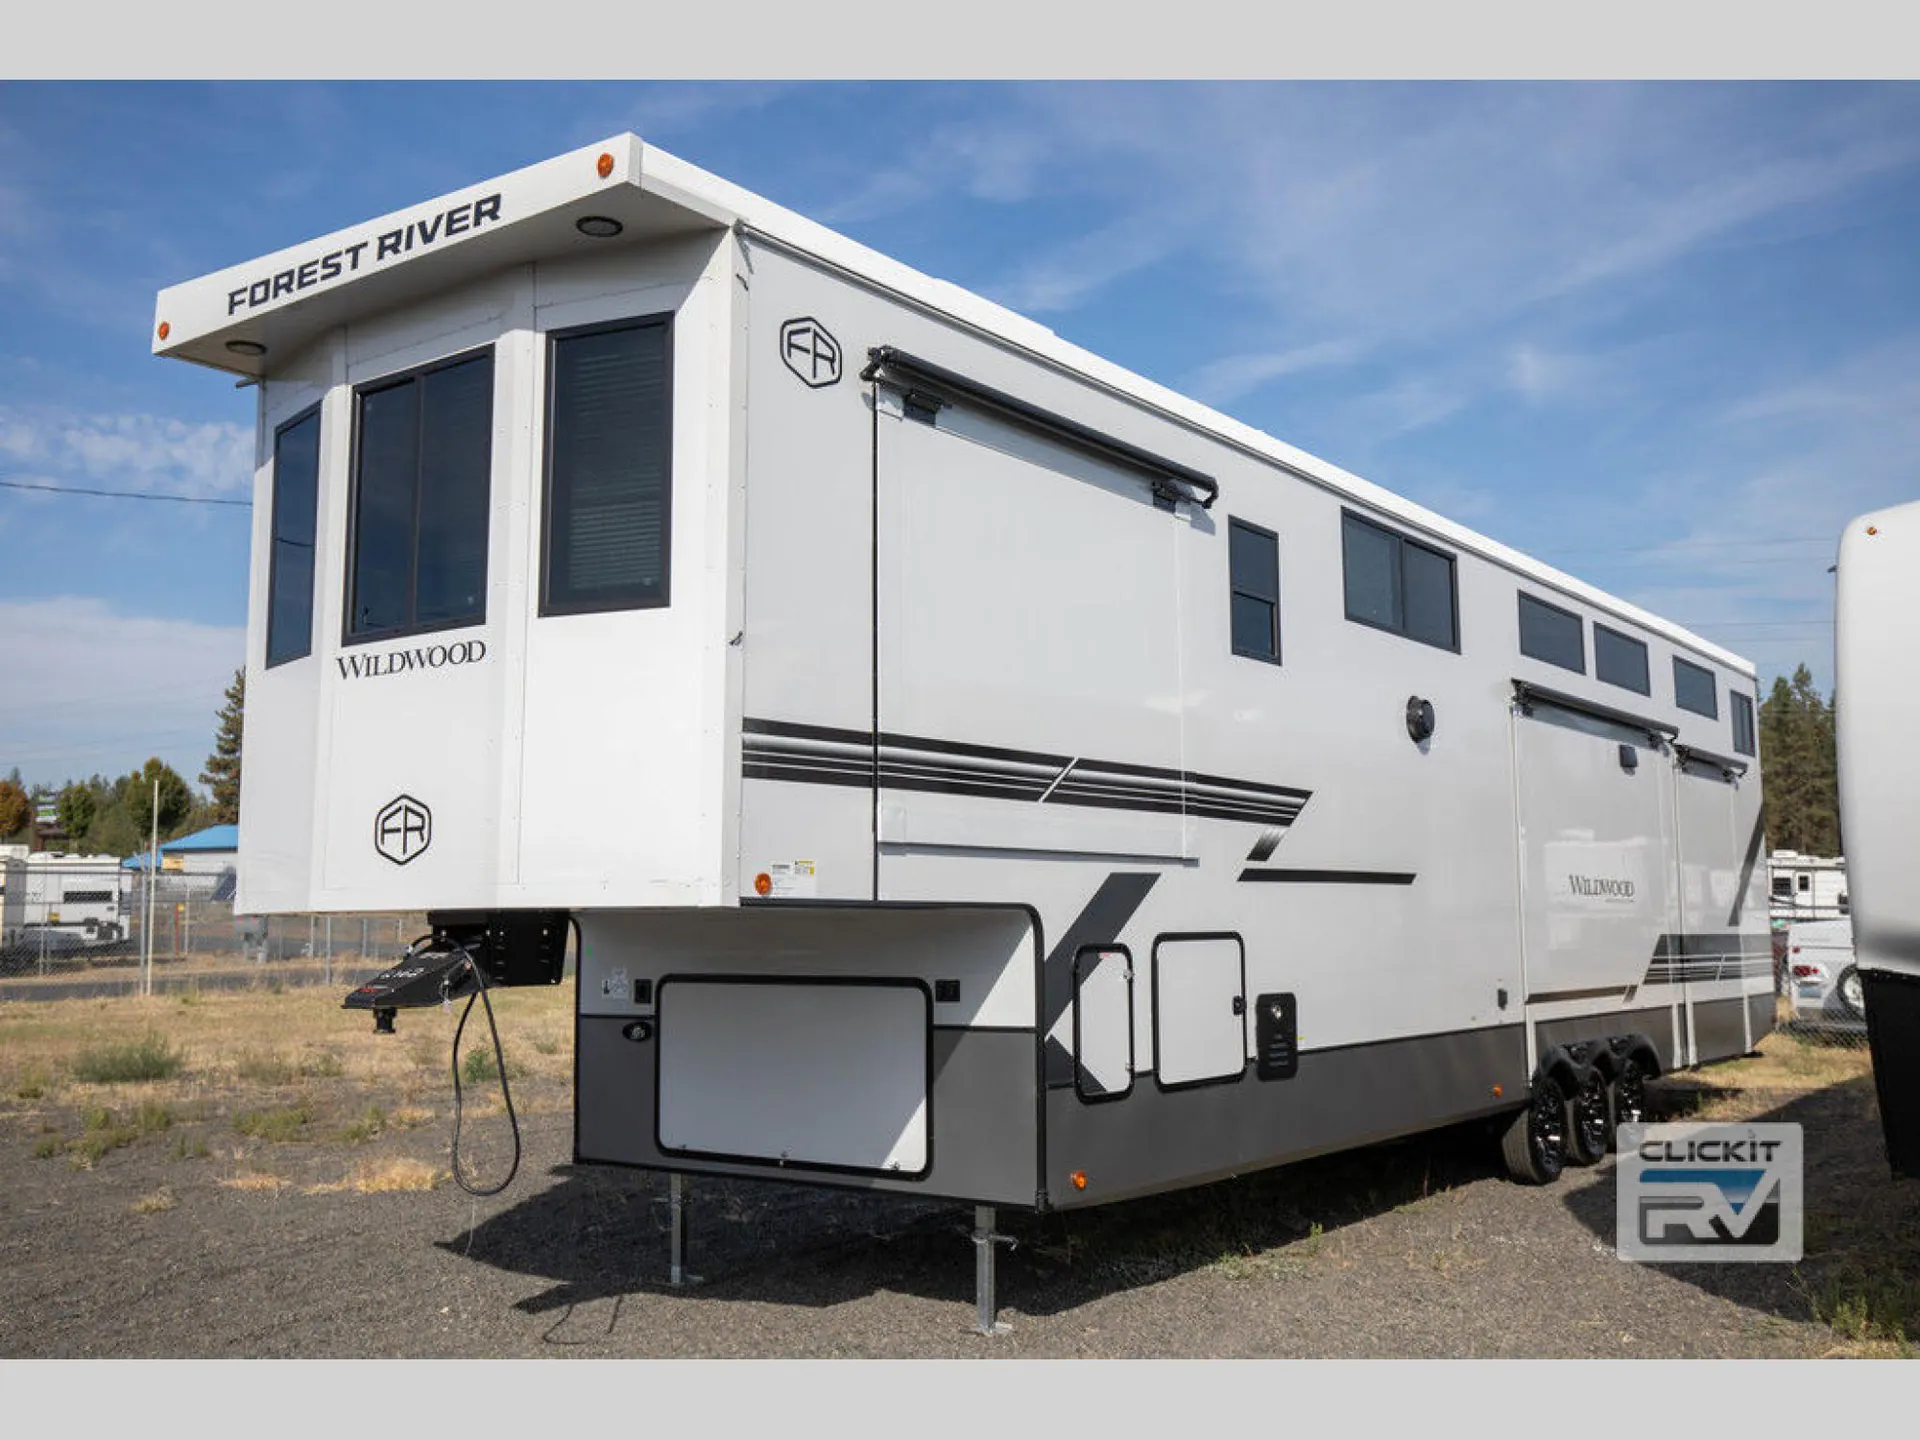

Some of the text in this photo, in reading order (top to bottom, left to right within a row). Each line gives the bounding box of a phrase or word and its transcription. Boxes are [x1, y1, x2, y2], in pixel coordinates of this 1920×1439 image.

[228, 194, 502, 315] FOREST RIVER
[337, 640, 486, 680] WILDWOOD
[1569, 874, 1634, 897] WILDWOOD
